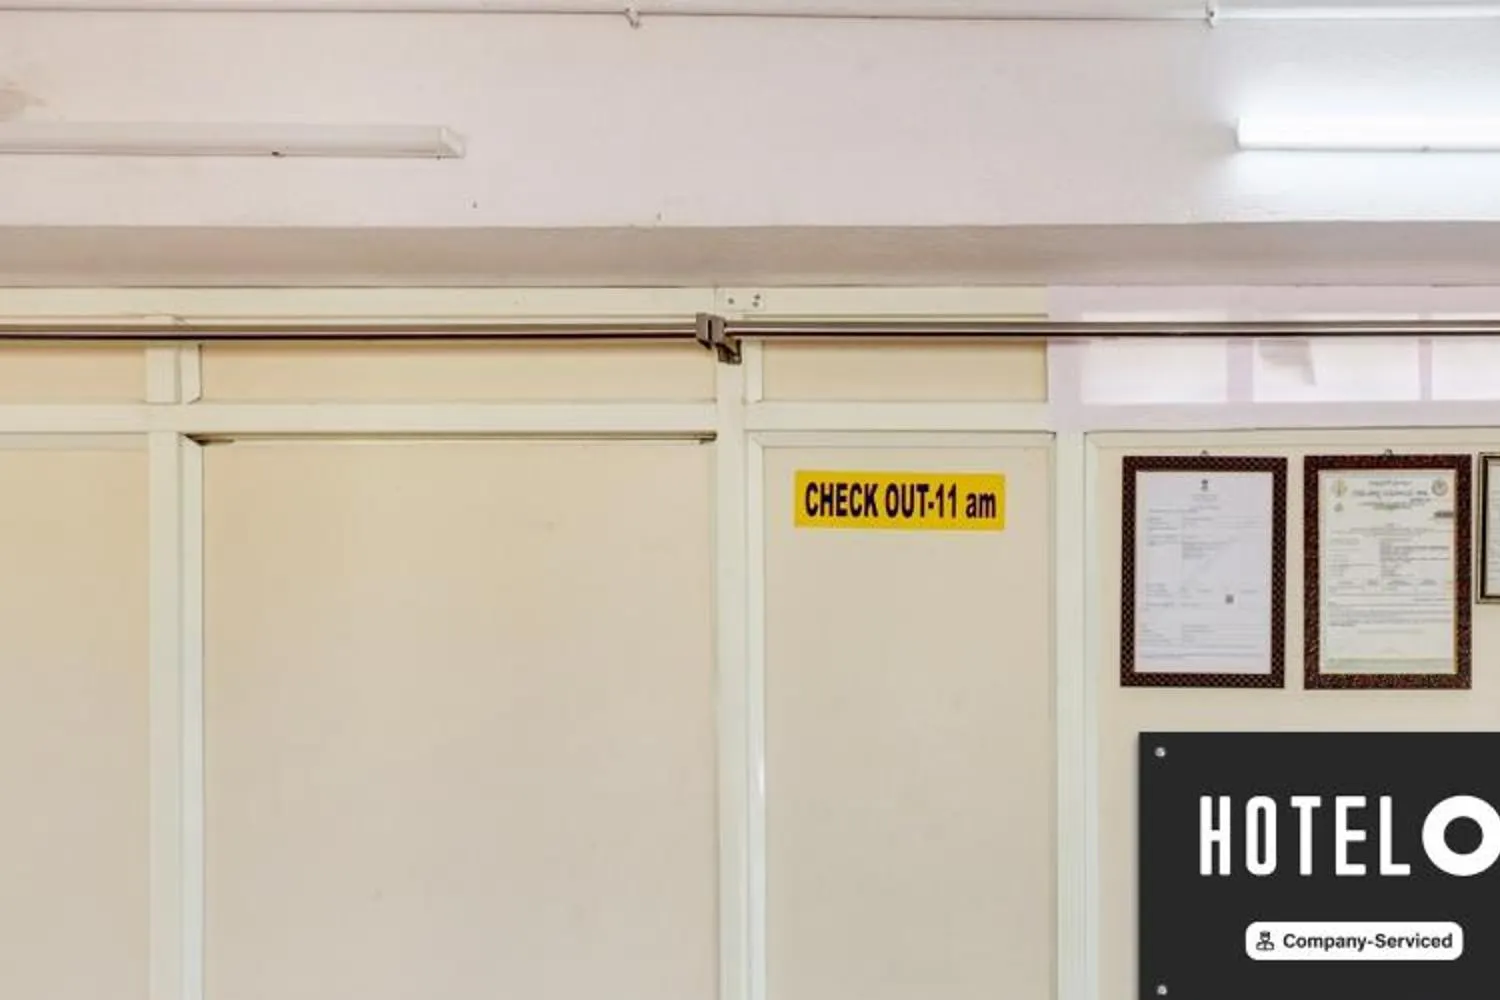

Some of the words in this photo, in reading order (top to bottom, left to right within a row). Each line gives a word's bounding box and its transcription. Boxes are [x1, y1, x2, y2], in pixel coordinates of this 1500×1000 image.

[805, 482, 879, 517] CHECK
[885, 483, 957, 518] OUT-11
[965, 492, 996, 518] am
[1283, 933, 1453, 952] Company-Serviced
